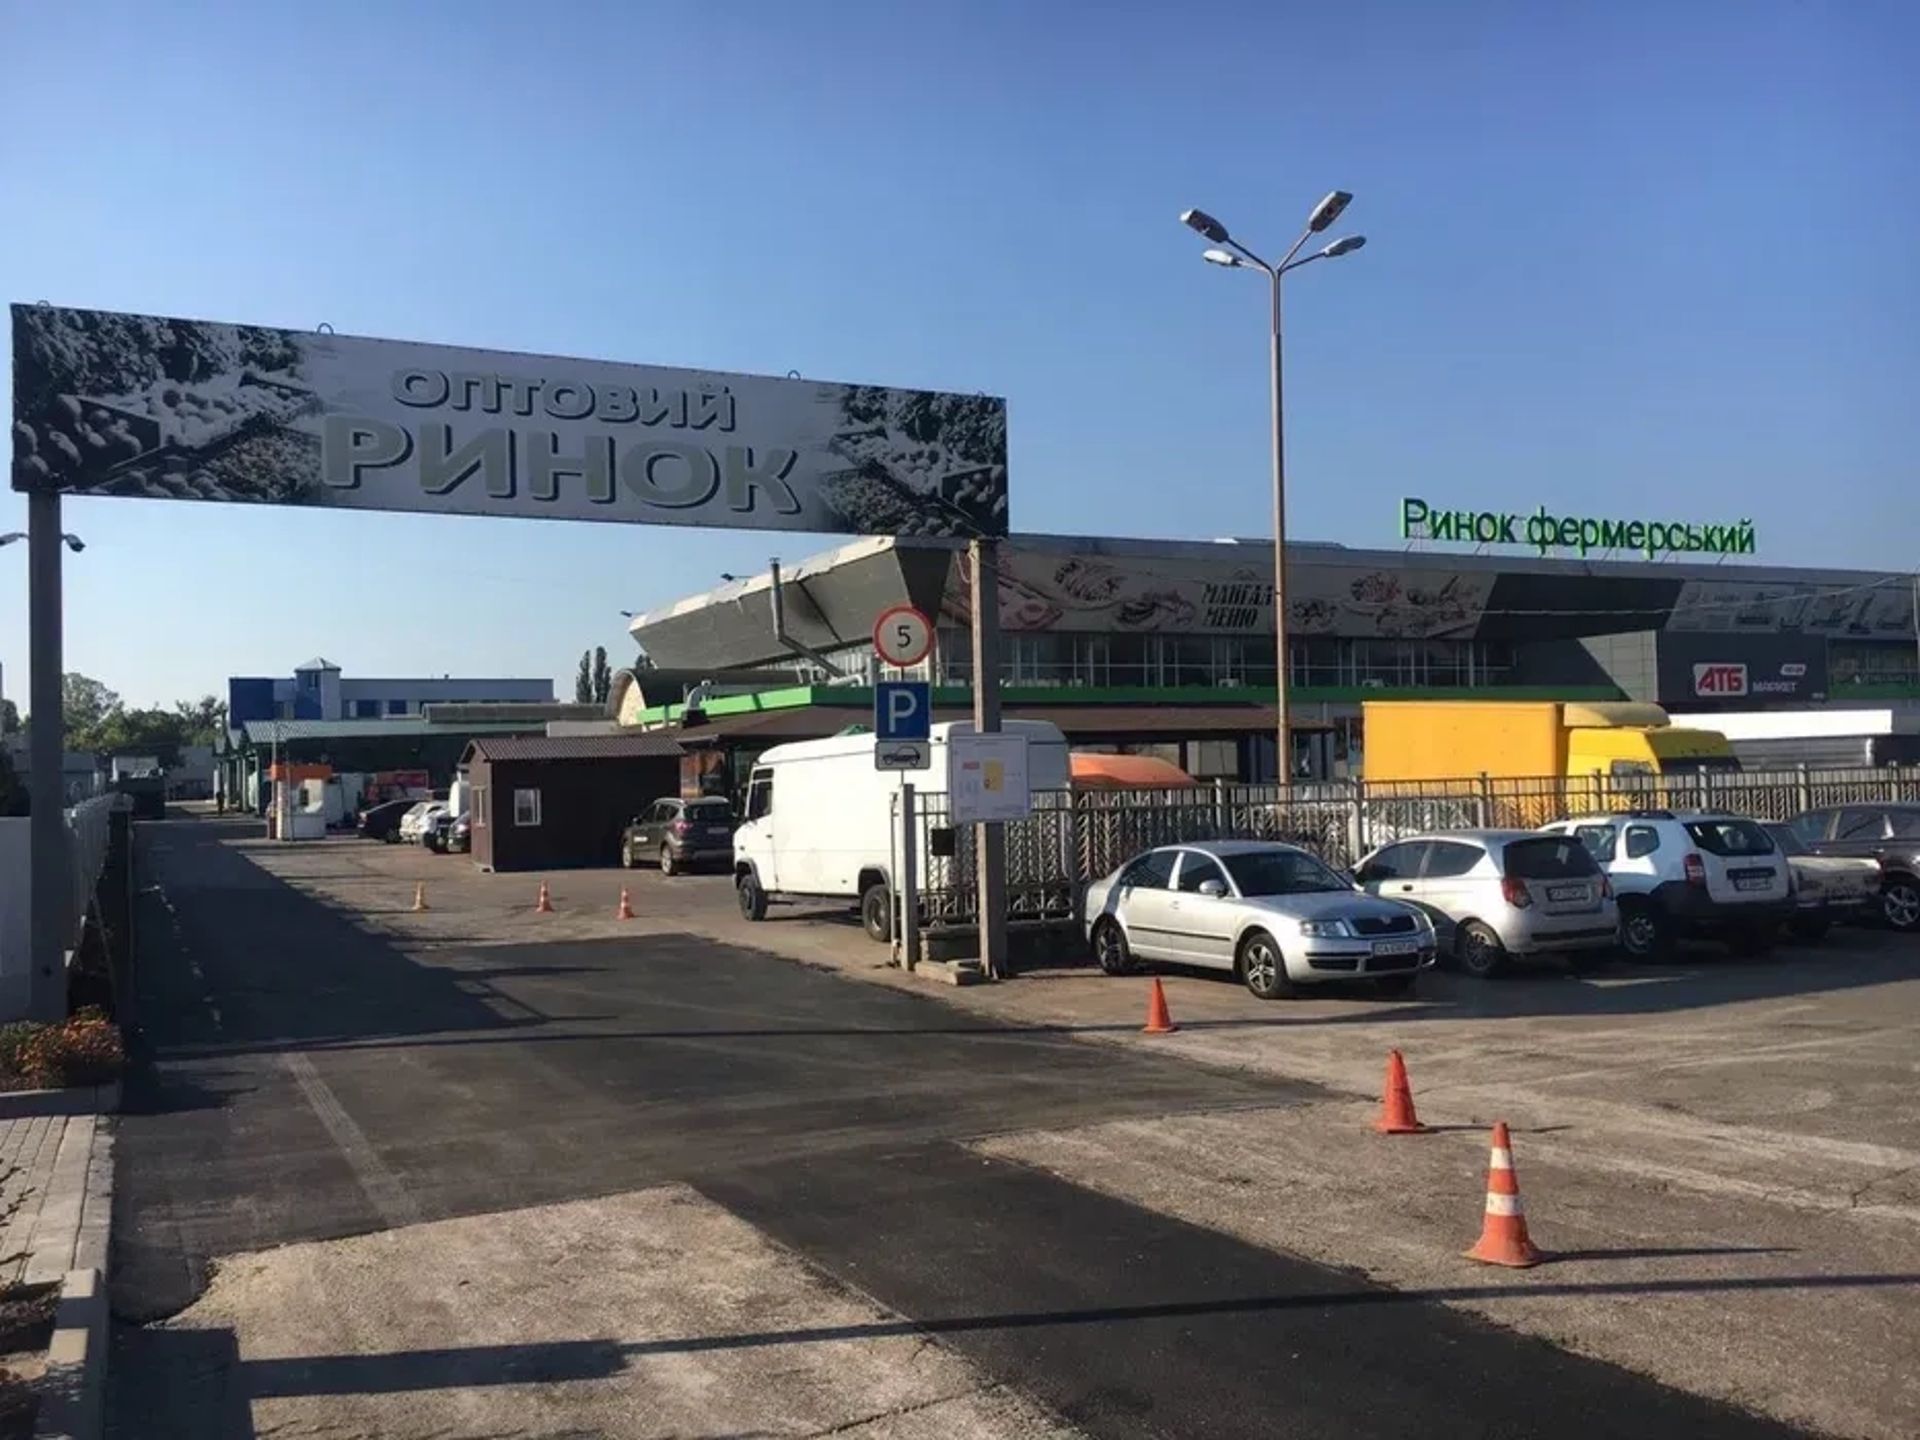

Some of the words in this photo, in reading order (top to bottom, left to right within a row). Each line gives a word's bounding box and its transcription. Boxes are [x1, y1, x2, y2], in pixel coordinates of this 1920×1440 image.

[393, 368, 737, 432] ОПТОВИЙ
[321, 418, 803, 515] РИНОК
[1400, 498, 1517, 543] Ринок
[1527, 505, 1756, 560] фермерський
[897, 625, 912, 648] 5
[1697, 666, 1744, 692] АТБ
[887, 689, 918, 734] P
